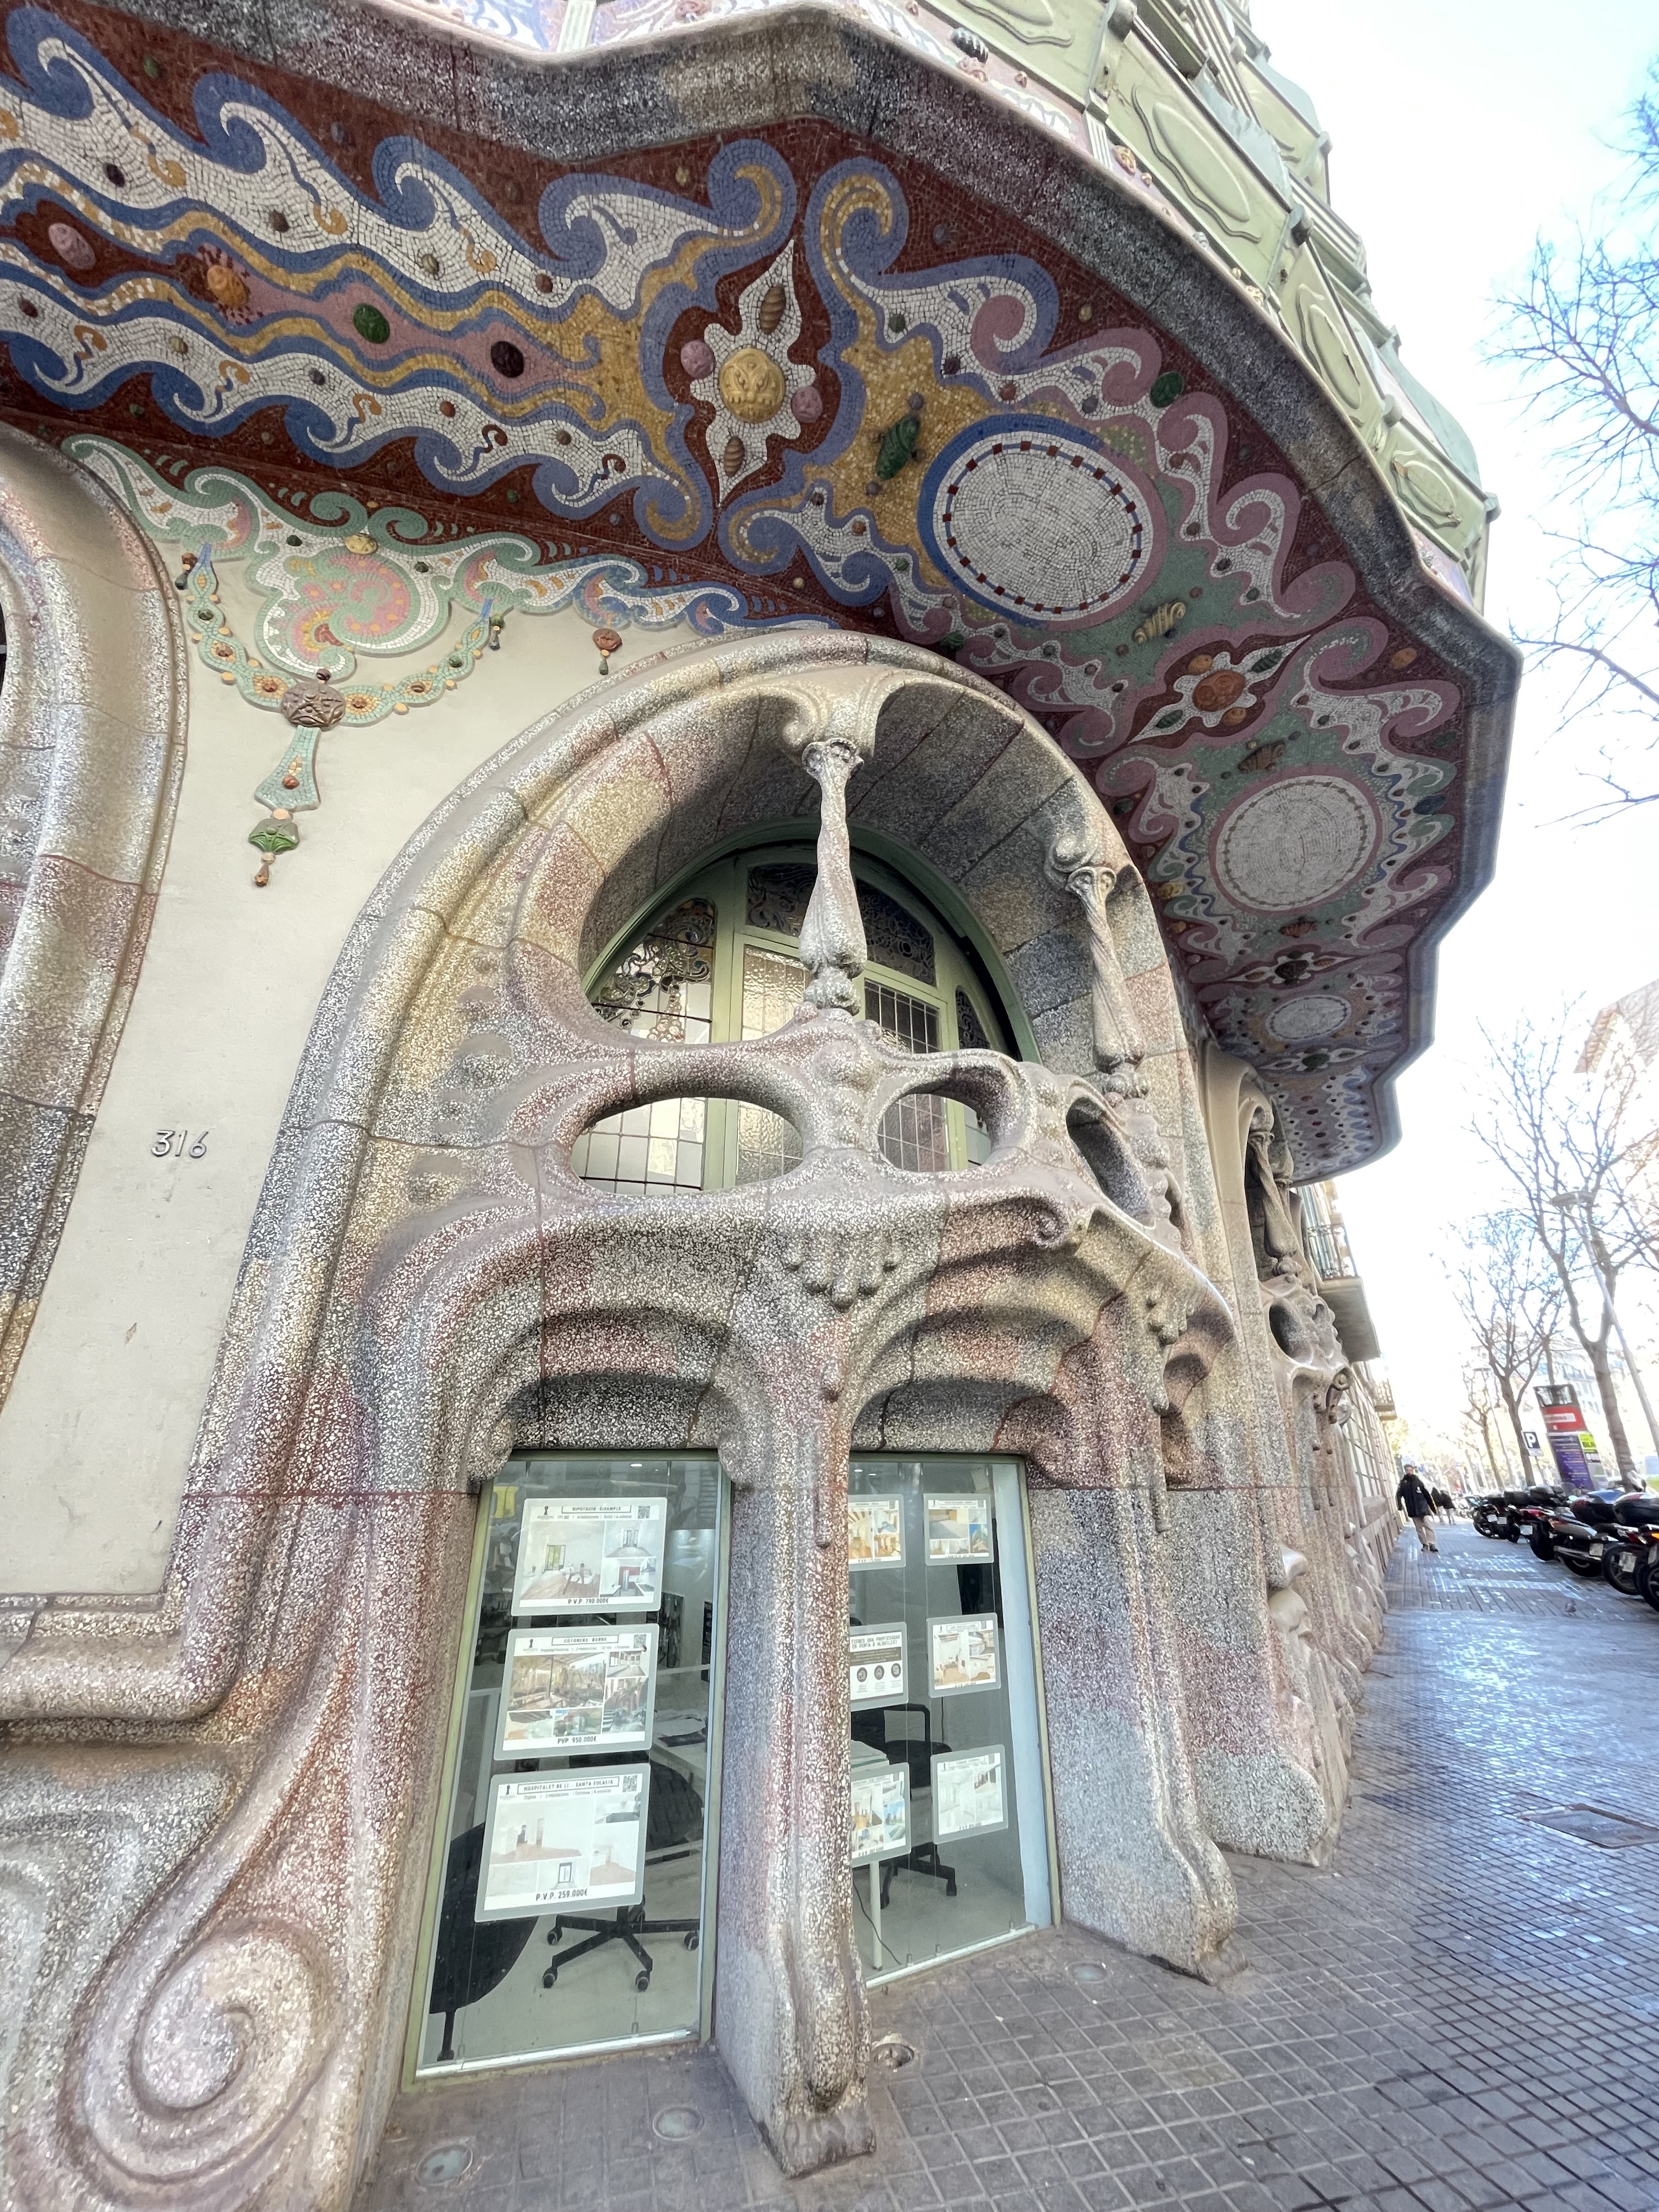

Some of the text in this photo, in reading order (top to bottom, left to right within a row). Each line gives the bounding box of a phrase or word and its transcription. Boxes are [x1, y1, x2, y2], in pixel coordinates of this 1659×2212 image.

[151, 1130, 209, 1159] 316
[1525, 1432, 1536, 1448] P
[524, 1784, 555, 1792] HOSPITALET
[558, 1888, 588, 1899] 259.000€
